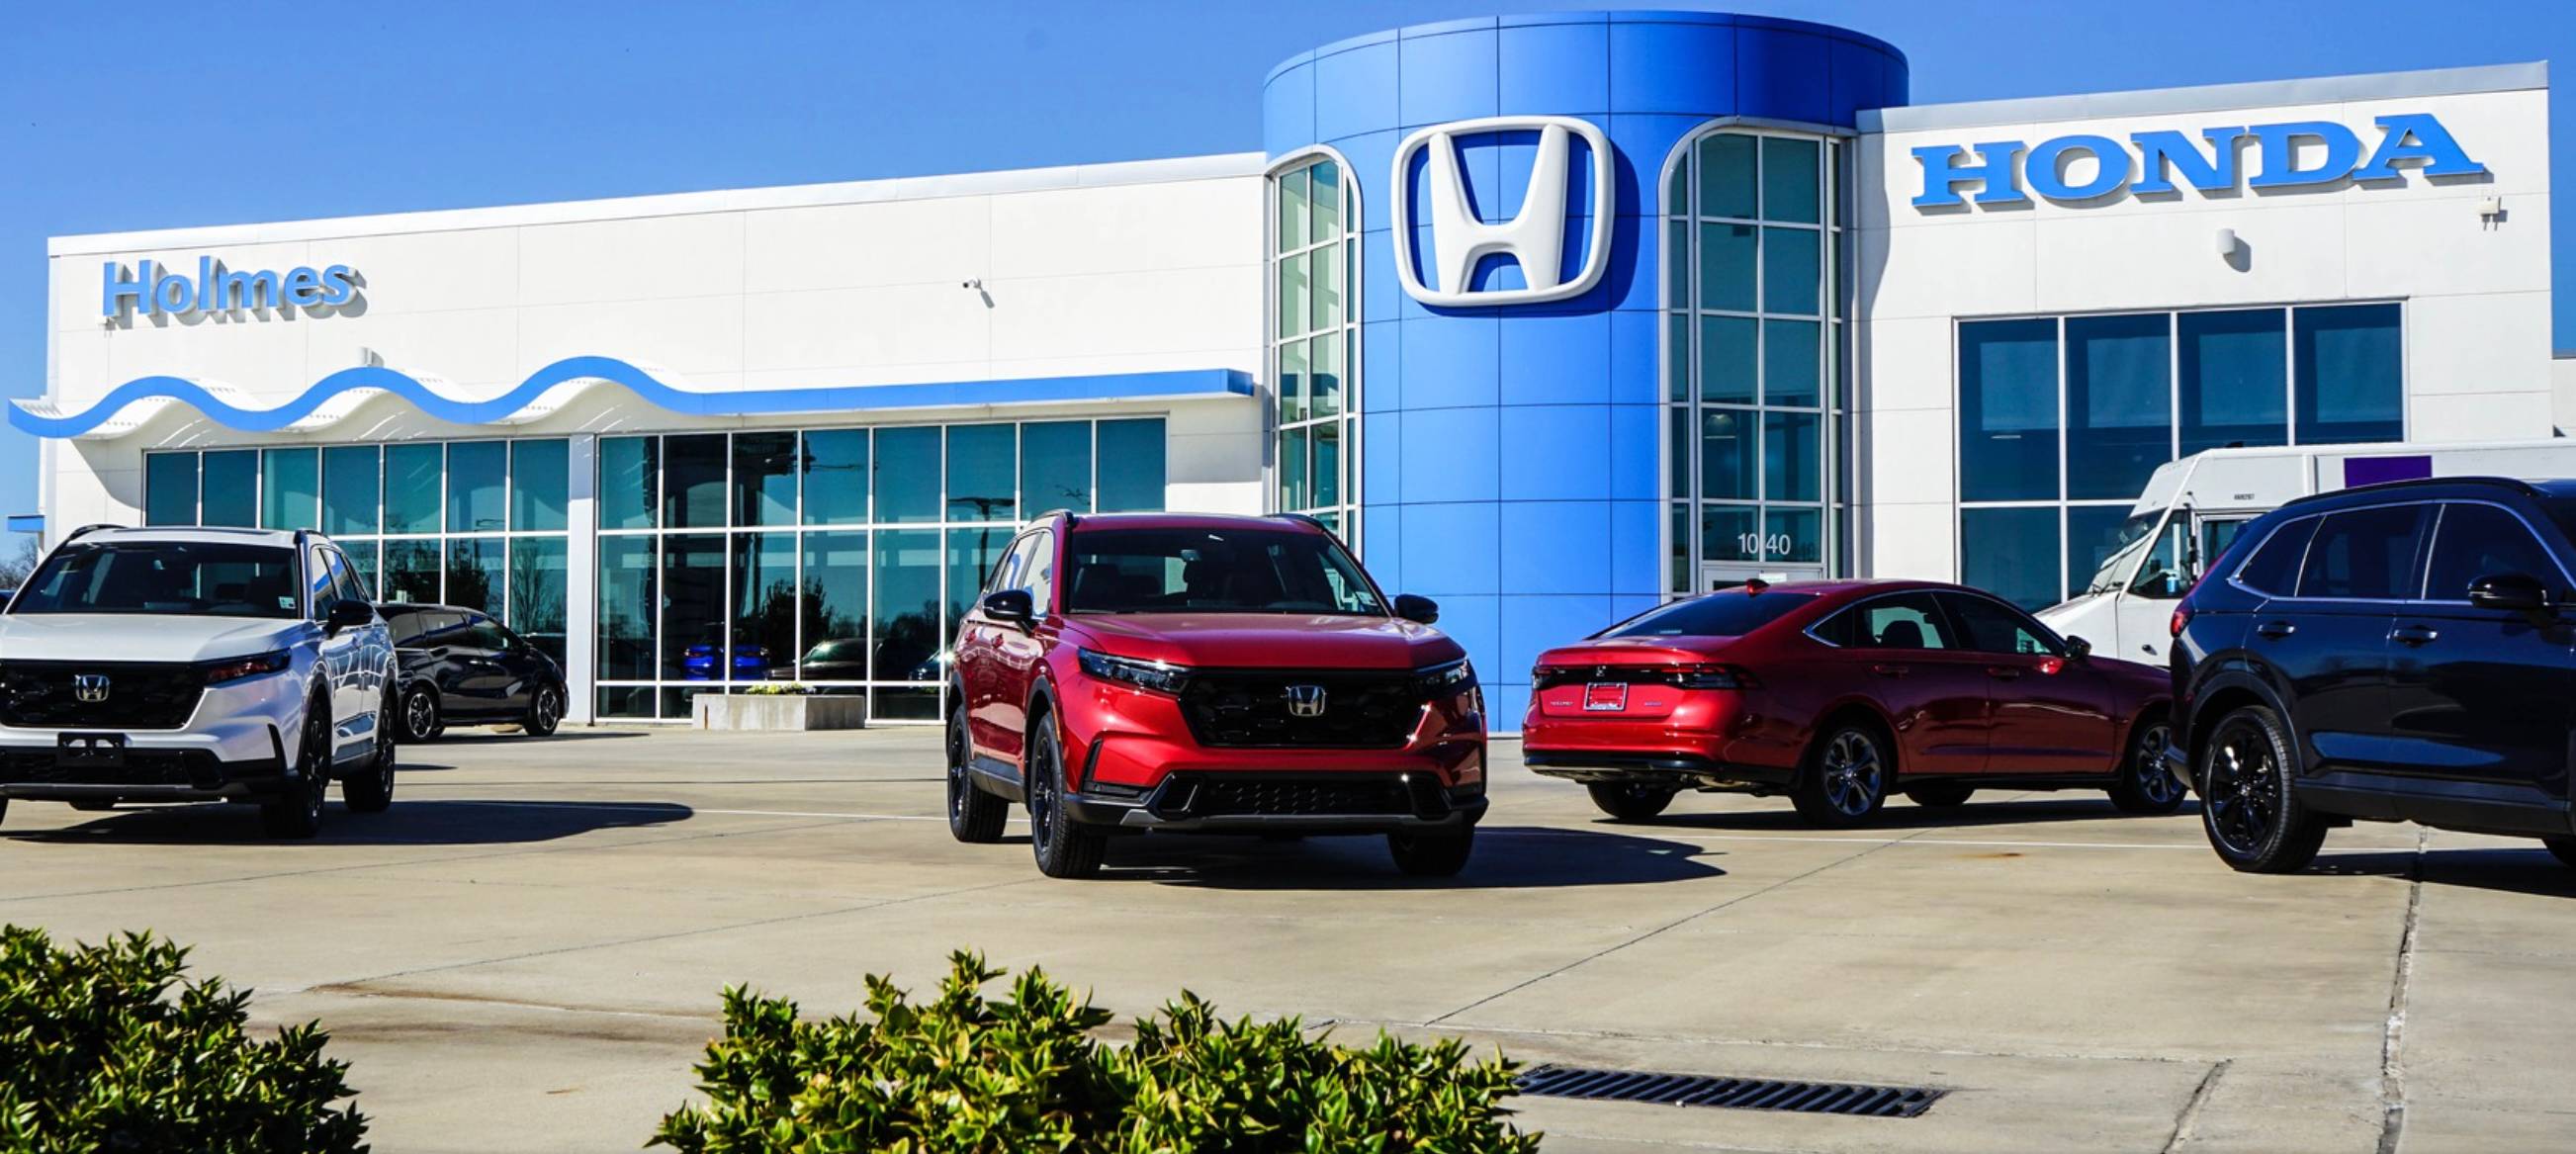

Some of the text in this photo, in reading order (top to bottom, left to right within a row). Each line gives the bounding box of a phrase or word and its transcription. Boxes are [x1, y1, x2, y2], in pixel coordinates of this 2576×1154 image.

[1911, 113, 2484, 206] HONDA
[103, 255, 353, 315] Holmes
[1737, 532, 1791, 555] 1040
